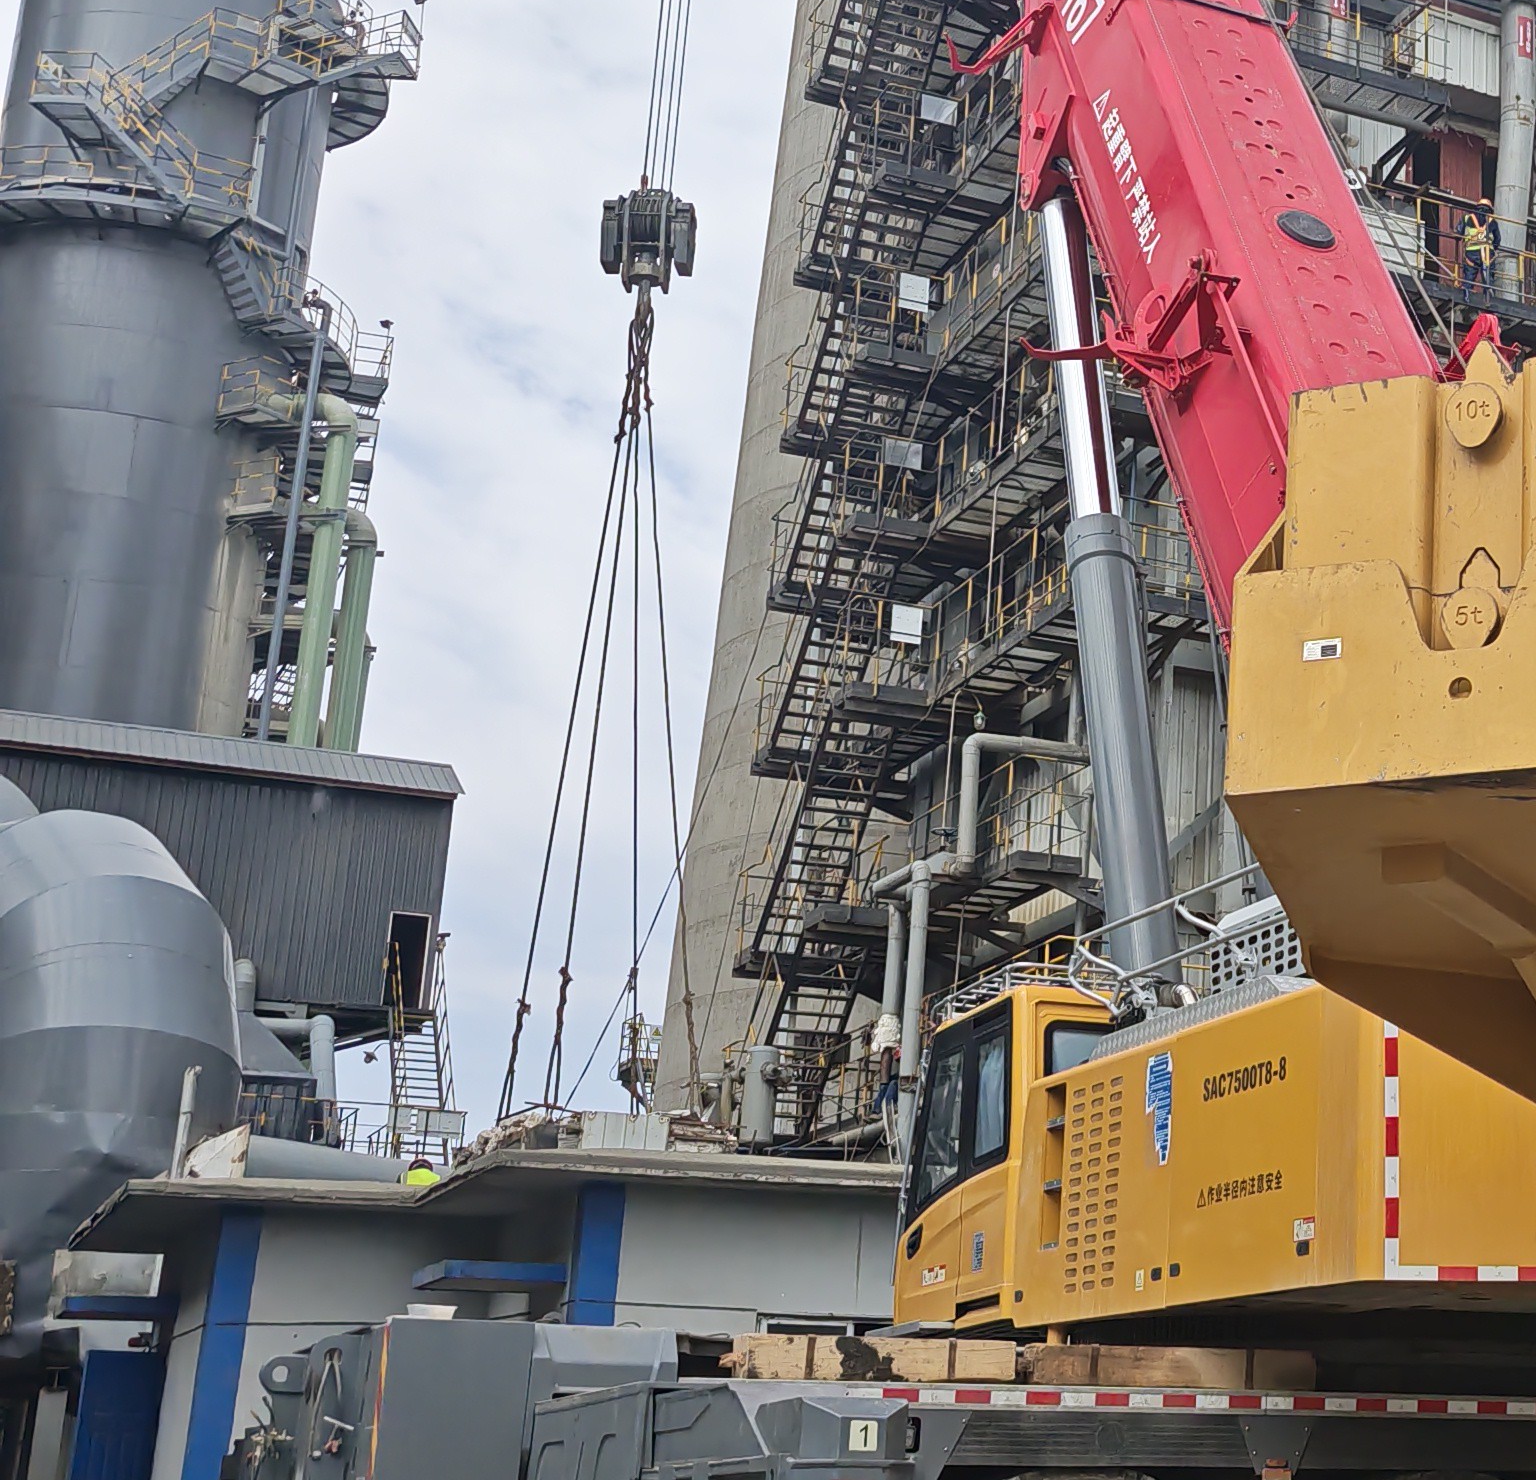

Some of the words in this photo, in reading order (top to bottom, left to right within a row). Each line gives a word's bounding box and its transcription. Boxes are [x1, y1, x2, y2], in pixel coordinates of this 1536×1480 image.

[1455, 400, 1490, 422] 10t
[1454, 605, 1484, 626] 5t
[1203, 1056, 1287, 1102] SAC7500T8-8
[1207, 1169, 1283, 1207] 作业半径内注意安全
[859, 1423, 869, 1448] 1
